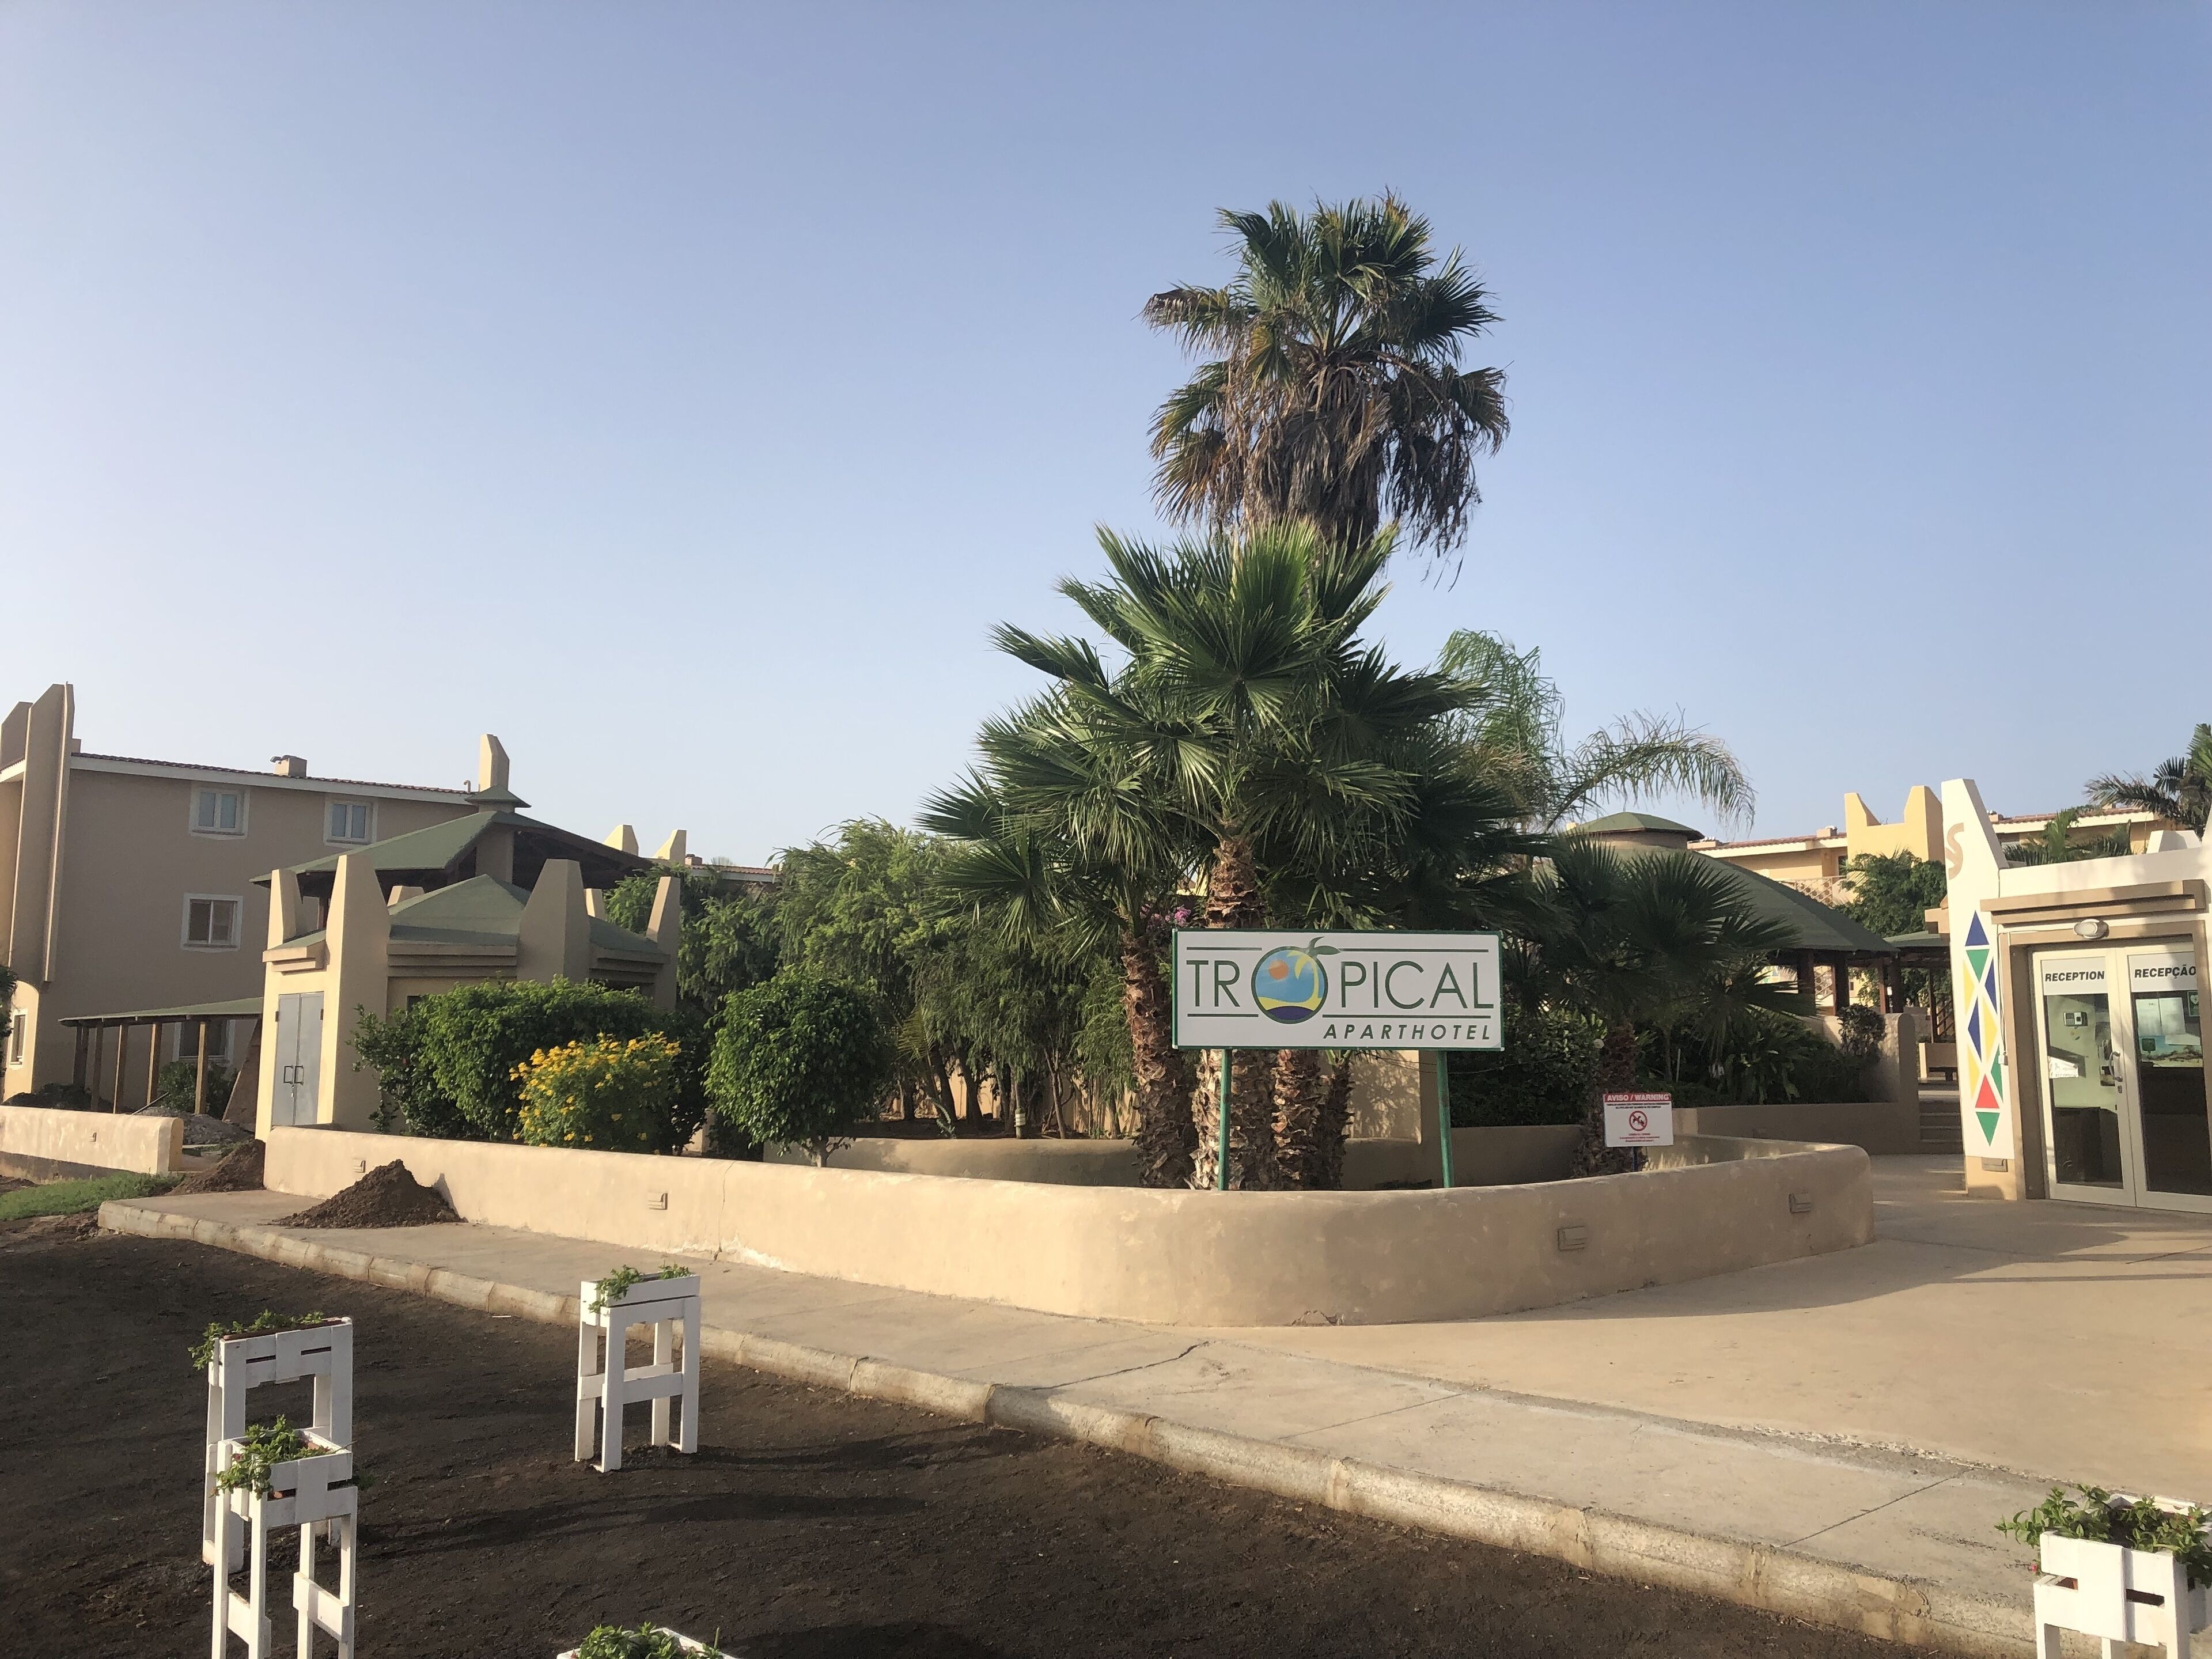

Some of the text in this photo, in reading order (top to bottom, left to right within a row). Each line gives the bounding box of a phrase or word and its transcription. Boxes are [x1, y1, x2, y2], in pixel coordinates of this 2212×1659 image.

[2045, 970, 2105, 982] RECEPTION
[2134, 964, 2196, 979] RECEPÇÃO
[1186, 946, 1494, 1024] TROPICAL
[1323, 1024, 1491, 1040] APARTHOTEL
